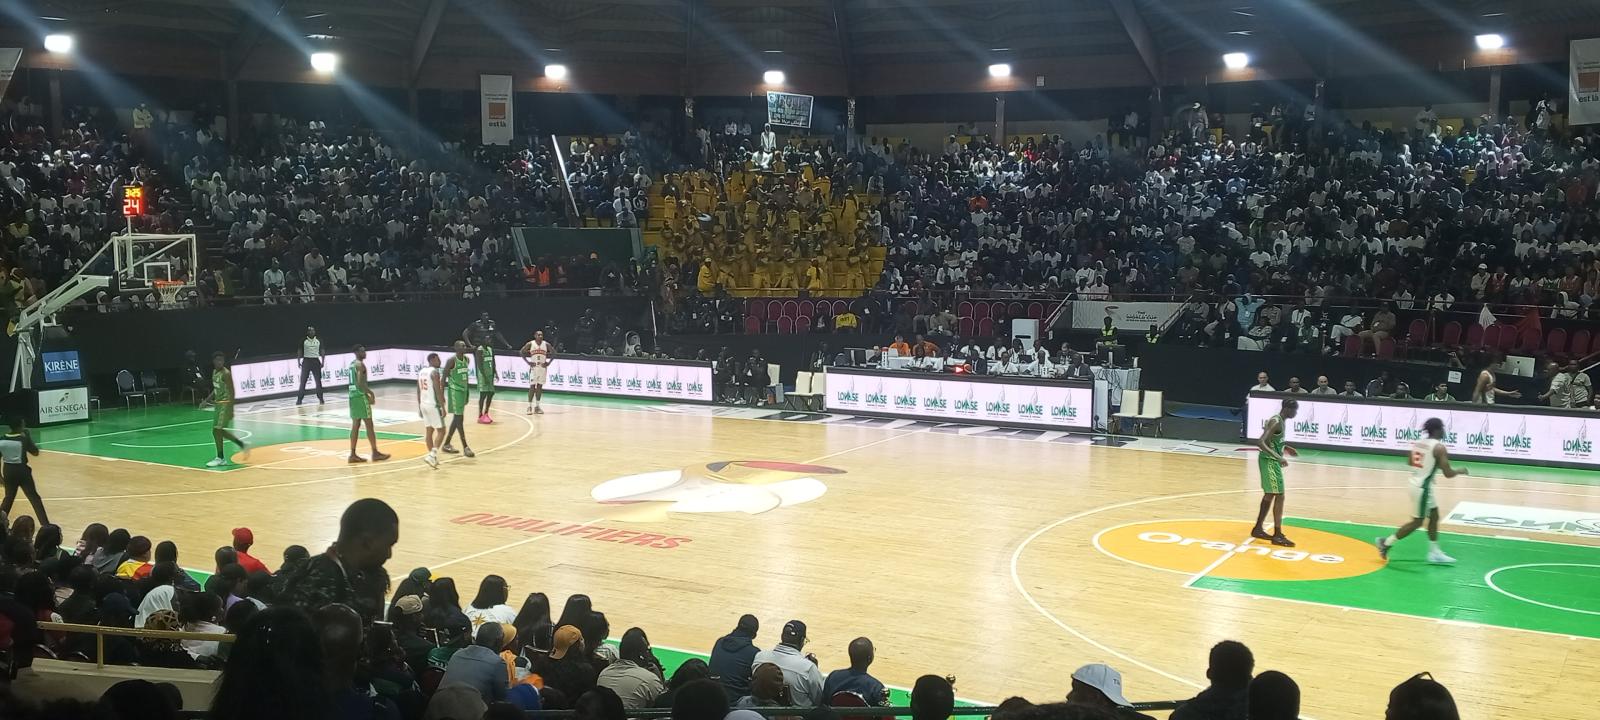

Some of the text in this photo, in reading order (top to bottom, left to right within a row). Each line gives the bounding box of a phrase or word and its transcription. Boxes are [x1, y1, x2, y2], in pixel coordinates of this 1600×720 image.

[123, 199, 140, 214] 24
[45, 360, 80, 372] KIRÈNE
[450, 513, 693, 549] QUALIFIERS
[1137, 531, 1346, 564] Orange
